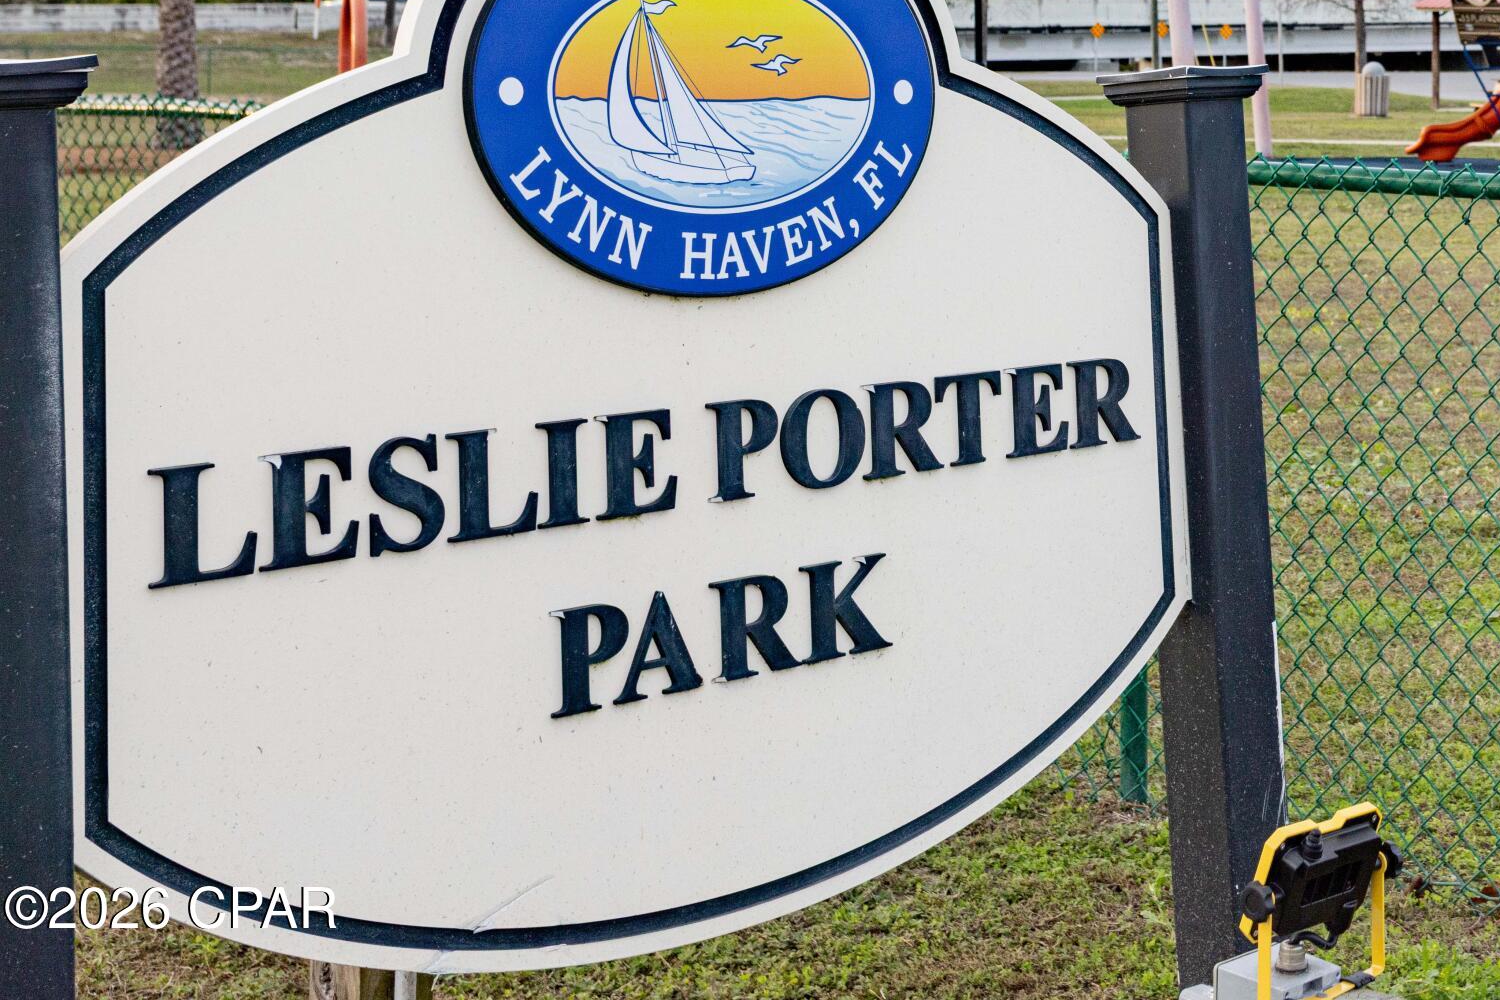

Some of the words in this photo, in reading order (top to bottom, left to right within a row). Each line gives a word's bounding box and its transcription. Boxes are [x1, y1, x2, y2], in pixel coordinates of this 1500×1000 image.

[509, 145, 653, 270] LYNN
[679, 195, 860, 280] HAVEN,
[853, 140, 914, 211] FL
[147, 408, 678, 590] LESLIE
[704, 358, 1142, 504] PORTER
[549, 552, 894, 719] PARK
